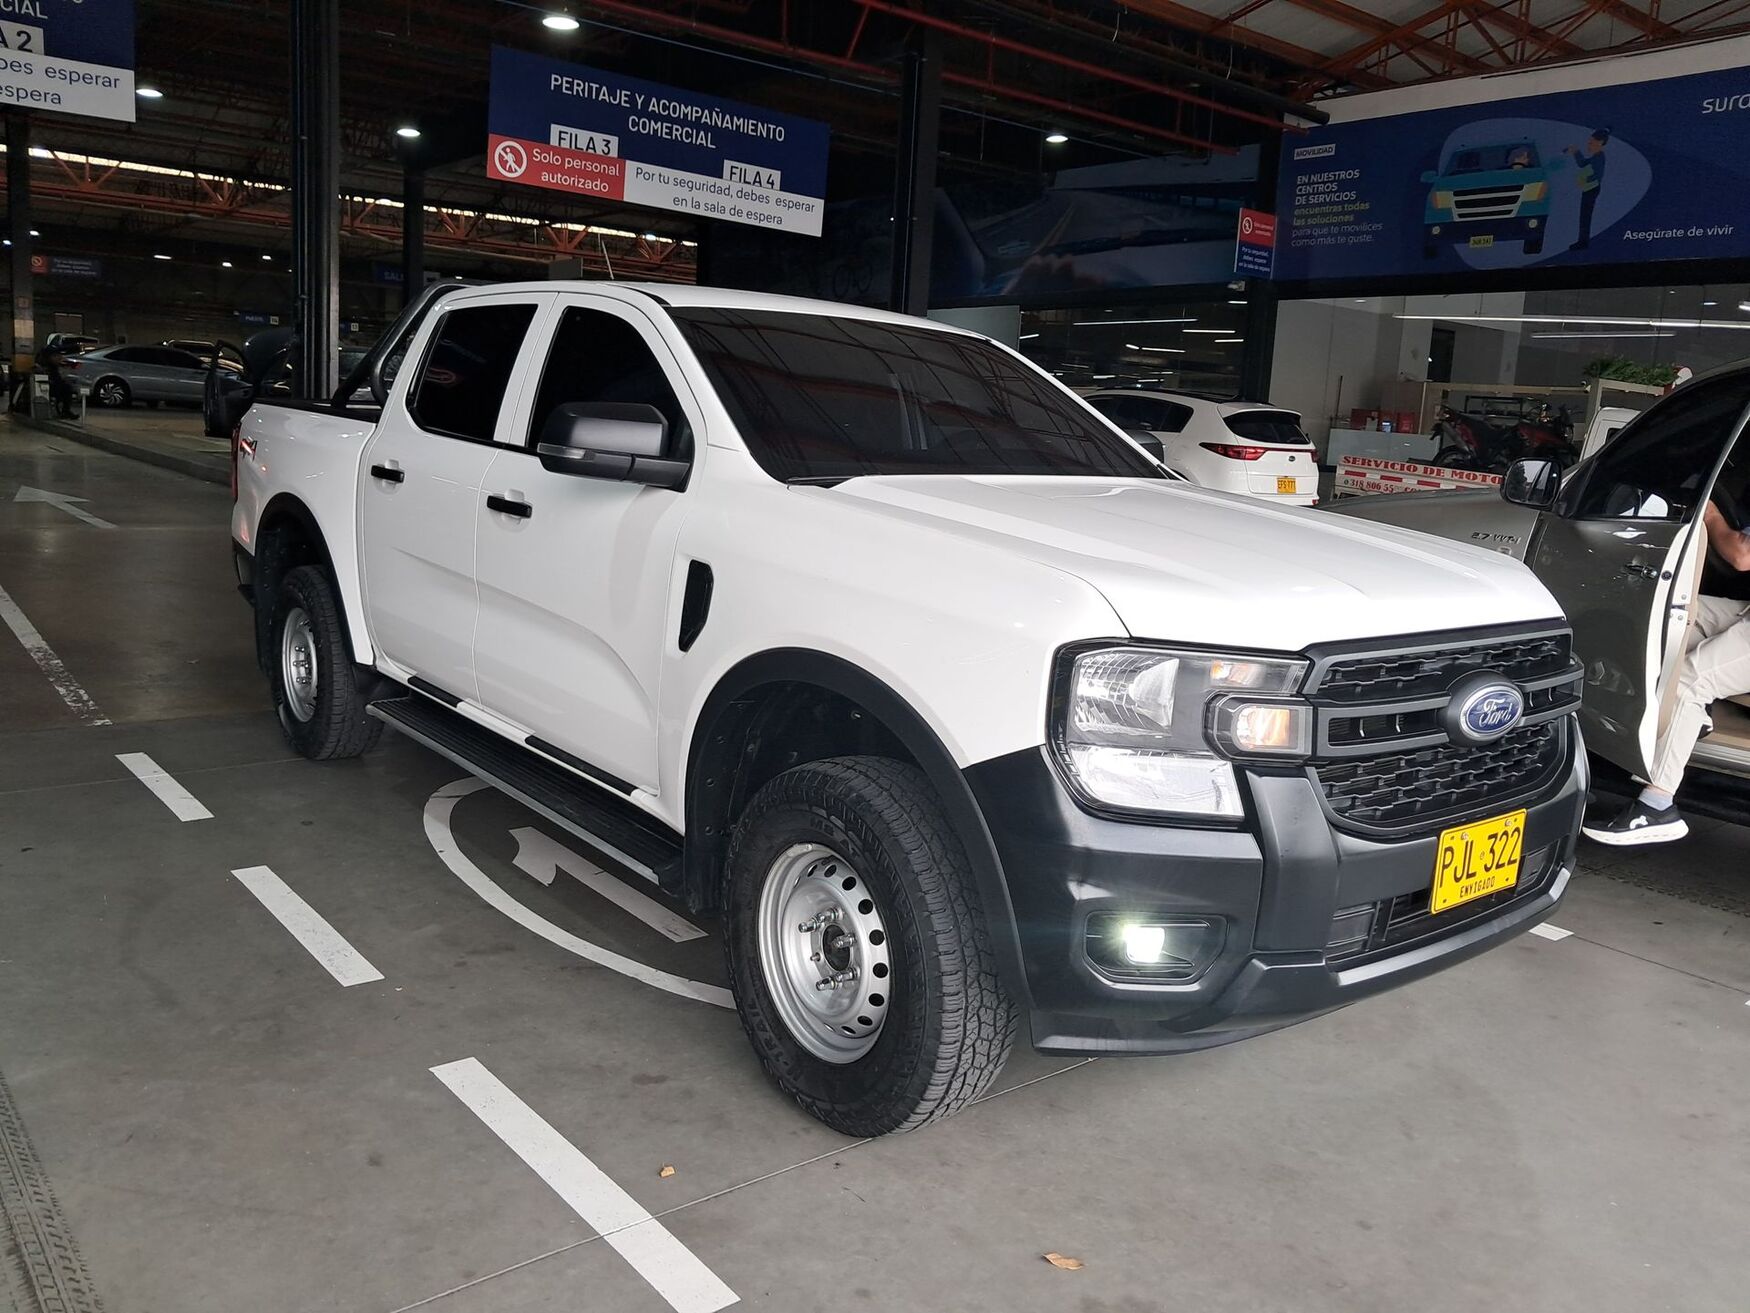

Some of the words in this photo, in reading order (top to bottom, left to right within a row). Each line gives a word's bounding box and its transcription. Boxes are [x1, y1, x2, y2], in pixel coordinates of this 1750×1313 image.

[16, 30, 33, 53] 2
[45, 66, 120, 88] esperar
[0, 84, 61, 105] spera
[1701, 93, 1750, 114] sura
[551, 74, 631, 107] PERITAJE
[635, 93, 645, 110] Y
[648, 97, 785, 142] ACOMPAÑAMIENTO
[558, 130, 597, 153] FILA
[601, 139, 611, 156] 3
[628, 115, 716, 149] COMERCIAL
[532, 148, 561, 165] Solo
[564, 157, 619, 176] personal
[541, 171, 609, 192] autorizado
[729, 165, 762, 187] FILA
[766, 174, 775, 189] 4
[1297, 174, 1308, 184] EN
[1310, 169, 1360, 183] NUESTROS
[635, 167, 655, 182] Por
[658, 173, 669, 185] tu
[673, 176, 733, 199] seguridad,
[736, 187, 770, 205] debes
[775, 197, 815, 213] esperar
[1295, 182, 1338, 194] CENTROS
[1295, 195, 1306, 205] DE
[1308, 191, 1357, 204] SERVICIOS
[673, 196, 687, 208] en
[691, 197, 700, 209] la
[704, 200, 726, 215] sala
[729, 205, 743, 218] de
[746, 209, 783, 226] espera
[1623, 228, 1684, 242] Asegúrate
[1687, 226, 1704, 237] de
[1707, 225, 1735, 236] vivir
[1342, 455, 1418, 473] SERVICIO
[1423, 466, 1445, 477] DE
[1479, 698, 1512, 728] Ford
[1440, 840, 1477, 889] PJL
[1484, 826, 1521, 873] 322
[1460, 876, 1496, 898] ENVIGADO
